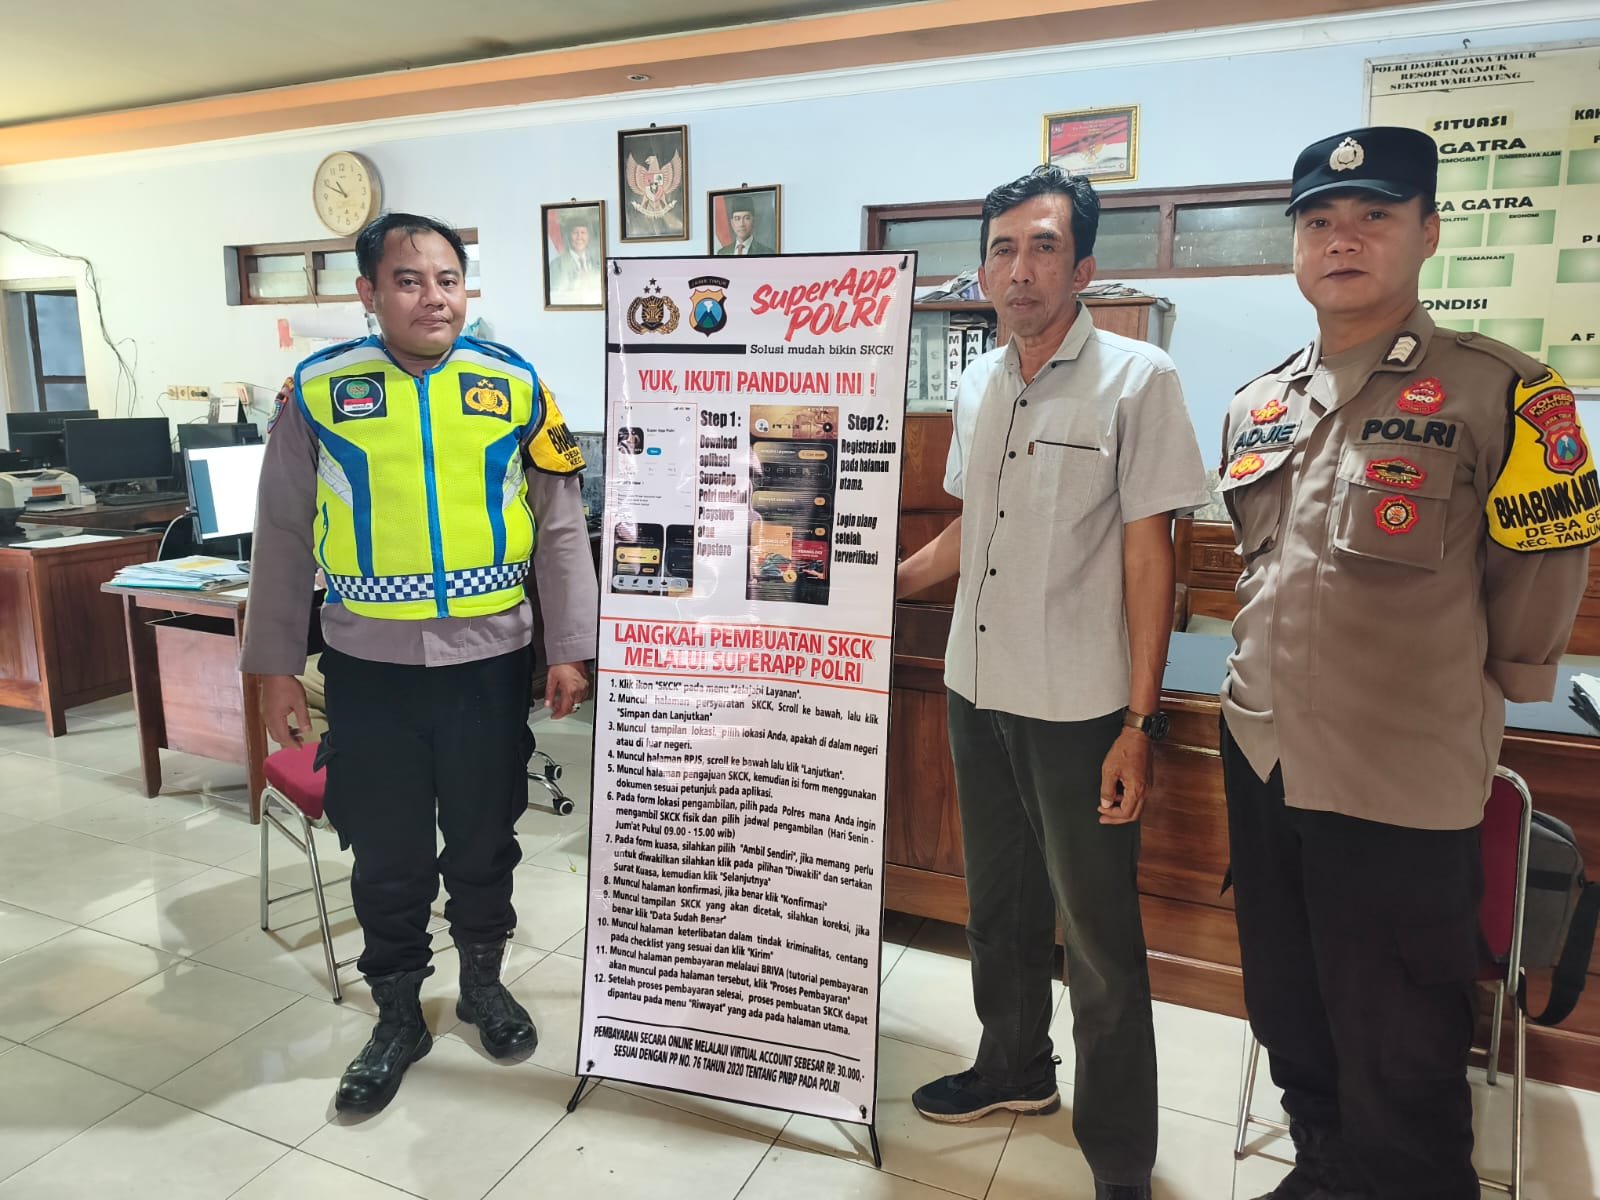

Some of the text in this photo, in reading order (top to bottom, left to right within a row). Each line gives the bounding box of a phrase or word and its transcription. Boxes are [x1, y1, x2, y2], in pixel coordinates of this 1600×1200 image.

[1372, 52, 1536, 74] POLRI DAERAH JAWA TIMUR
[1400, 64, 1508, 80] RESORT NGANJUK
[1390, 72, 1520, 90] SEKTOR WARUJAYENG
[1433, 116, 1508, 132] SITUASI
[1439, 138, 1526, 154] GATRA
[1462, 196, 1533, 210] GATRA
[750, 266, 896, 316] SuperApp
[784, 295, 891, 342] POLRI
[750, 344, 893, 355] Solusi mudah bikin SKCK!
[638, 370, 678, 394] YUK,
[684, 370, 731, 392] IKUTI
[737, 371, 830, 394] PANDUAN
[836, 373, 862, 394] INI
[1529, 394, 1573, 415] POLRES
[700, 410, 728, 428] Step
[848, 414, 875, 432] Step
[700, 434, 737, 449] Download
[1234, 423, 1296, 450] ADJIE
[1362, 418, 1456, 448] POLRI
[841, 439, 896, 455] Registrasi akun
[700, 454, 730, 468] aplikasi
[841, 458, 889, 472] pada halaman
[700, 470, 736, 486] SuperApp
[840, 477, 863, 490] utama.
[699, 488, 718, 503] Polri
[837, 512, 877, 530] Login ulang
[1525, 520, 1580, 538] DESA
[835, 531, 861, 545] setelah
[1516, 538, 1552, 548] KEC.
[834, 550, 878, 565] terverifikasi
[614, 623, 874, 659] LANGKAH PEMBUATAN SKCK
[624, 647, 862, 683] MELALUI SUPERAPP POLRI
[651, 709, 668, 719] dan
[615, 777, 652, 790] dokumen
[653, 783, 678, 792] sesuai
[680, 783, 717, 796] petunjuk
[718, 784, 739, 796] pada
[641, 822, 662, 835] Pukul
[613, 862, 634, 873] Surat
[661, 867, 701, 879] kemudian
[703, 870, 717, 880] klik
[612, 875, 640, 888] Muncul
[641, 879, 675, 892] halaman
[724, 885, 739, 898] jika
[741, 887, 763, 900] benar
[764, 890, 778, 902] klik
[610, 932, 628, 943] pada
[630, 935, 663, 948] checklist
[665, 941, 685, 952] yang
[687, 942, 712, 952] sesuai
[713, 943, 729, 954] dan
[731, 944, 745, 955] klik
[608, 959, 626, 971] akan
[628, 964, 656, 976] muncul
[658, 967, 678, 978] pada
[679, 968, 714, 981] halaman
[753, 977, 767, 989] klik
[593, 1025, 638, 1042] PEMBAYARAN
[640, 1031, 666, 1046] SECARA
[668, 1034, 692, 1050] ONLINE
[694, 1039, 728, 1056] MELALAUI
[730, 1045, 756, 1061] VIRTUAL
[759, 1050, 792, 1067] ACCOUNT
[794, 1056, 824, 1072] SEBESAR
[613, 1044, 637, 1058] SESUAI
[638, 1047, 667, 1063] DENGAN
[668, 1051, 678, 1064] PP
[692, 1055, 701, 1069] 76
[703, 1057, 726, 1073] TAHUN
[726, 1061, 744, 1076] 2020
[745, 1064, 777, 1082] TENTANG
[778, 1070, 797, 1085] PNBP
[798, 1073, 817, 1089] PADA
[819, 1077, 839, 1093] POLRI
